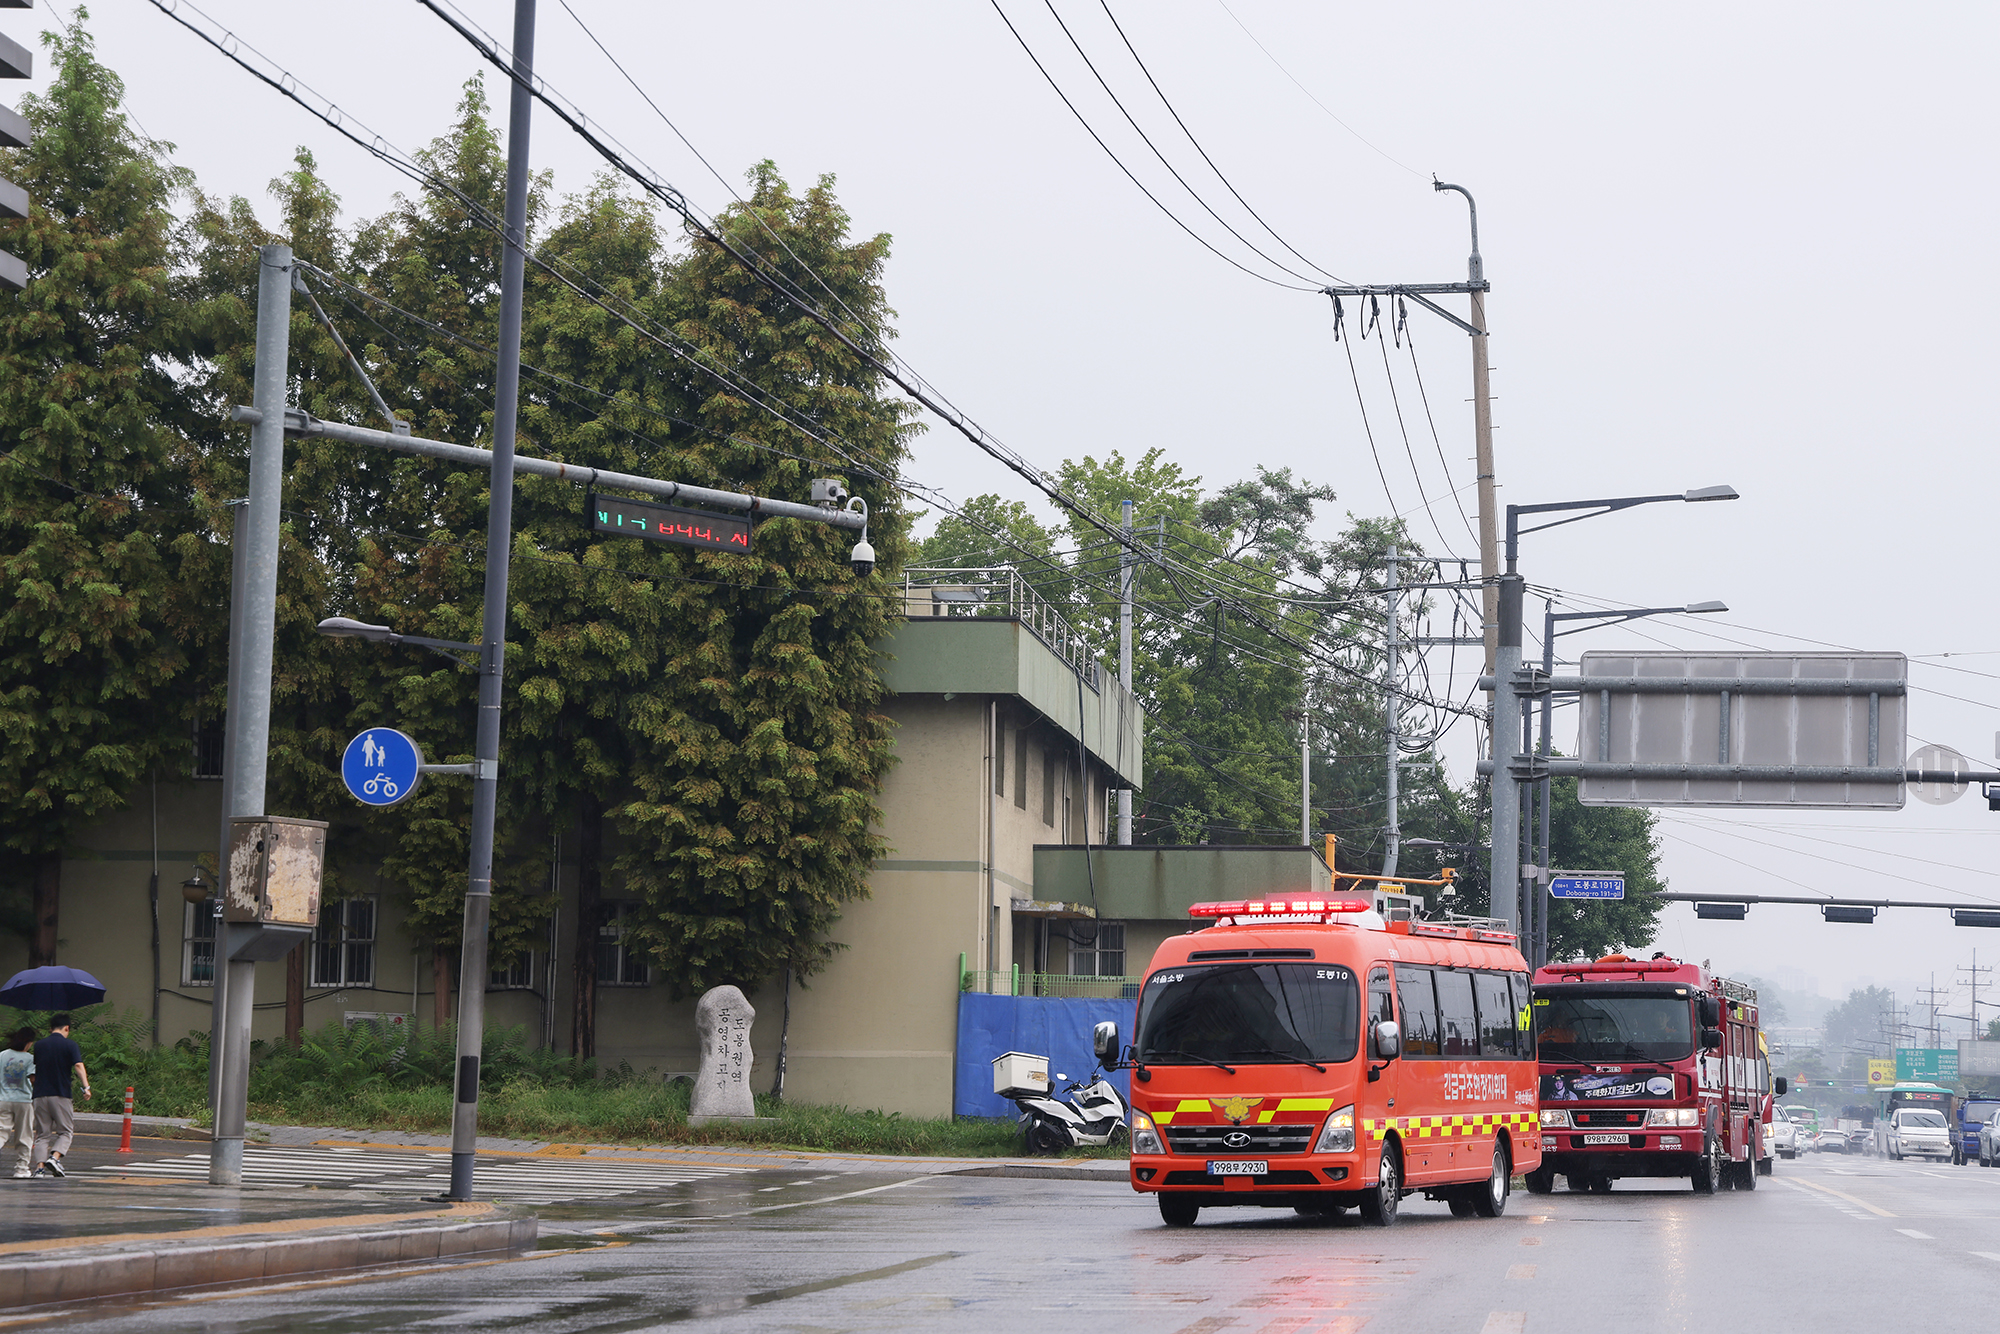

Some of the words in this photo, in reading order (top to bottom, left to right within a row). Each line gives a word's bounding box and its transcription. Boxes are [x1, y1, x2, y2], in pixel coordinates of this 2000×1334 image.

[1574, 880, 1621, 891] 도봉로191길
[1152, 973, 1185, 984] 서울소방
[1316, 969, 1348, 981] 도봉10
[1444, 1073, 1507, 1101] 긴급구조현장지휘대
[1607, 1134, 1627, 1143] 2960
[1241, 1162, 1266, 1173] 2930
